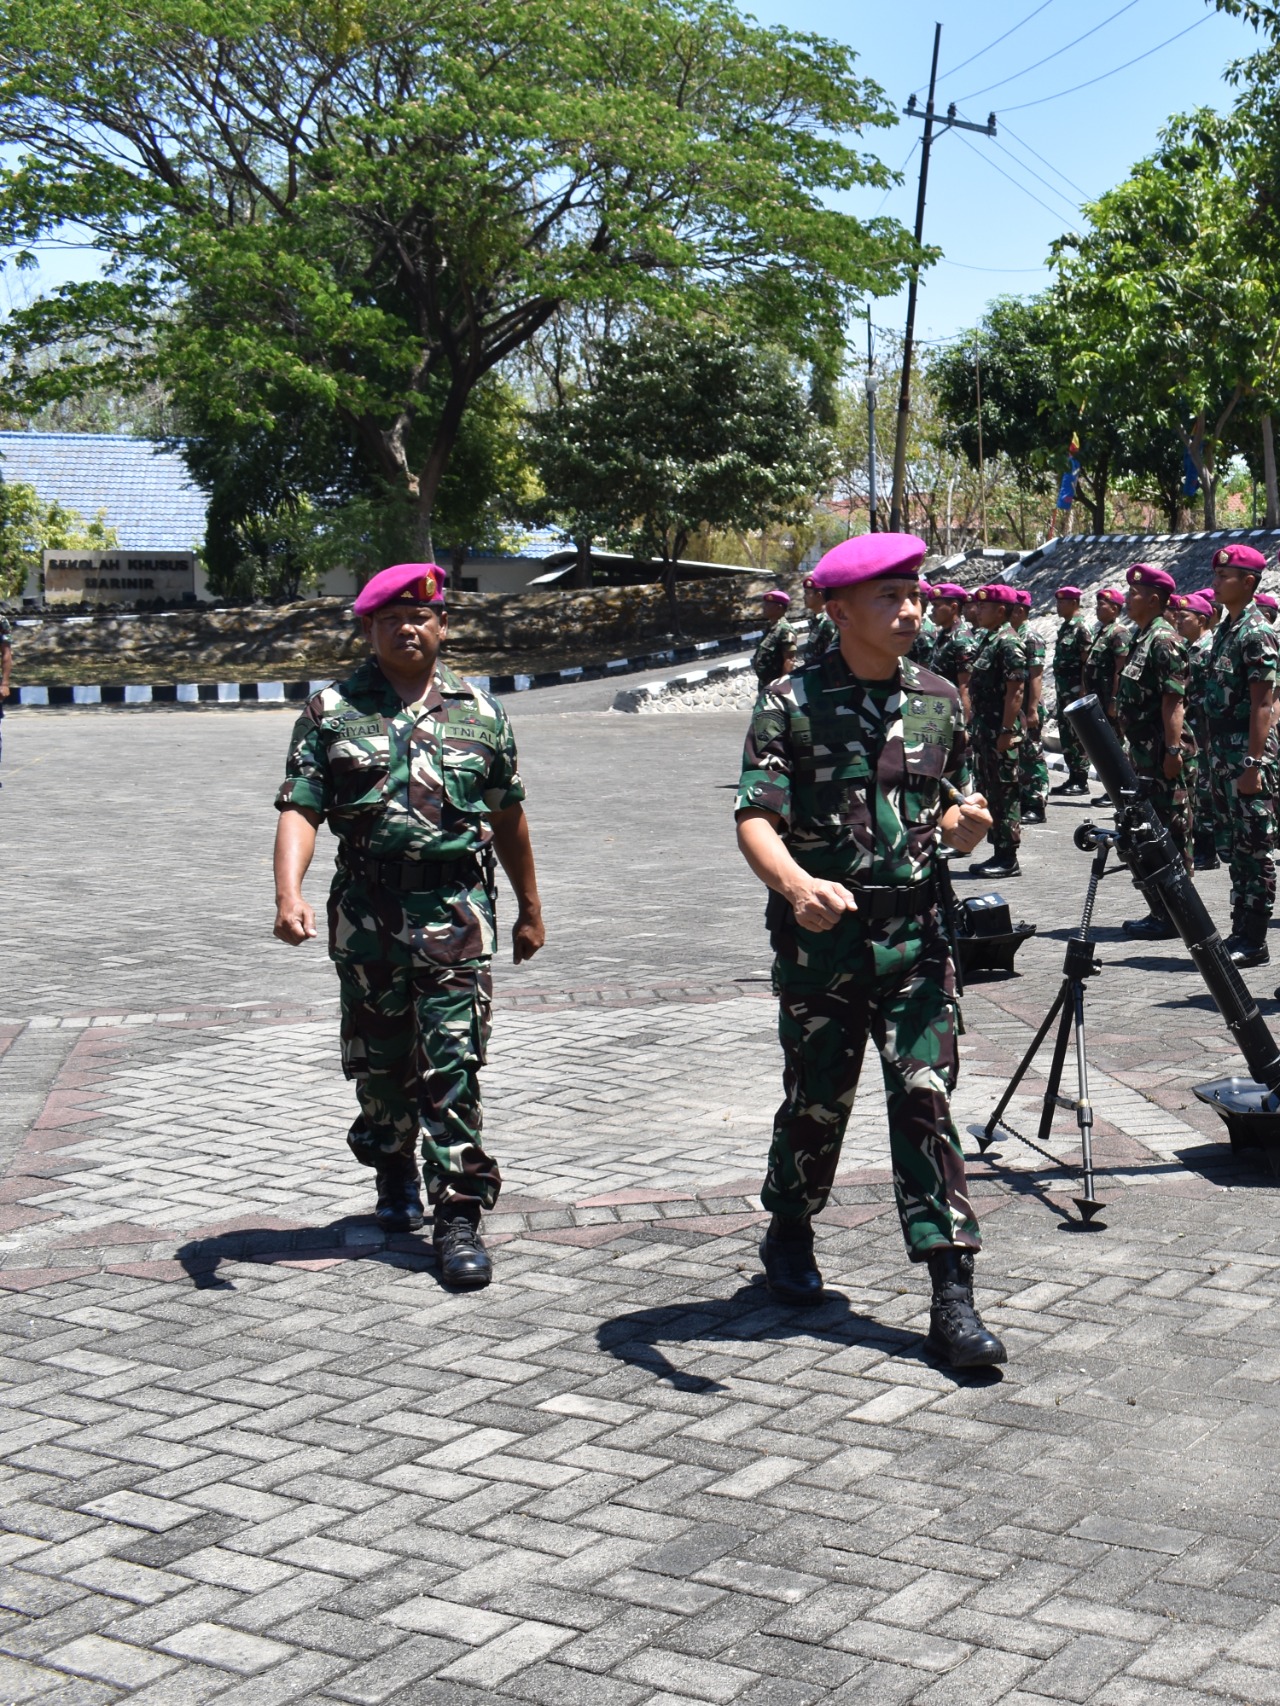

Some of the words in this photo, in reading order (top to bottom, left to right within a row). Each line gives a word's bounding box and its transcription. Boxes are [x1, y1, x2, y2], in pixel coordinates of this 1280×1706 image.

[49, 558, 120, 571] SEKOLAH
[128, 558, 189, 571] KHUSUS
[85, 577, 154, 590] MARINIR
[450, 726, 475, 738] TNI
[480, 731, 494, 745] AL
[912, 732, 933, 744] TNI
[937, 733, 948, 746] AL
